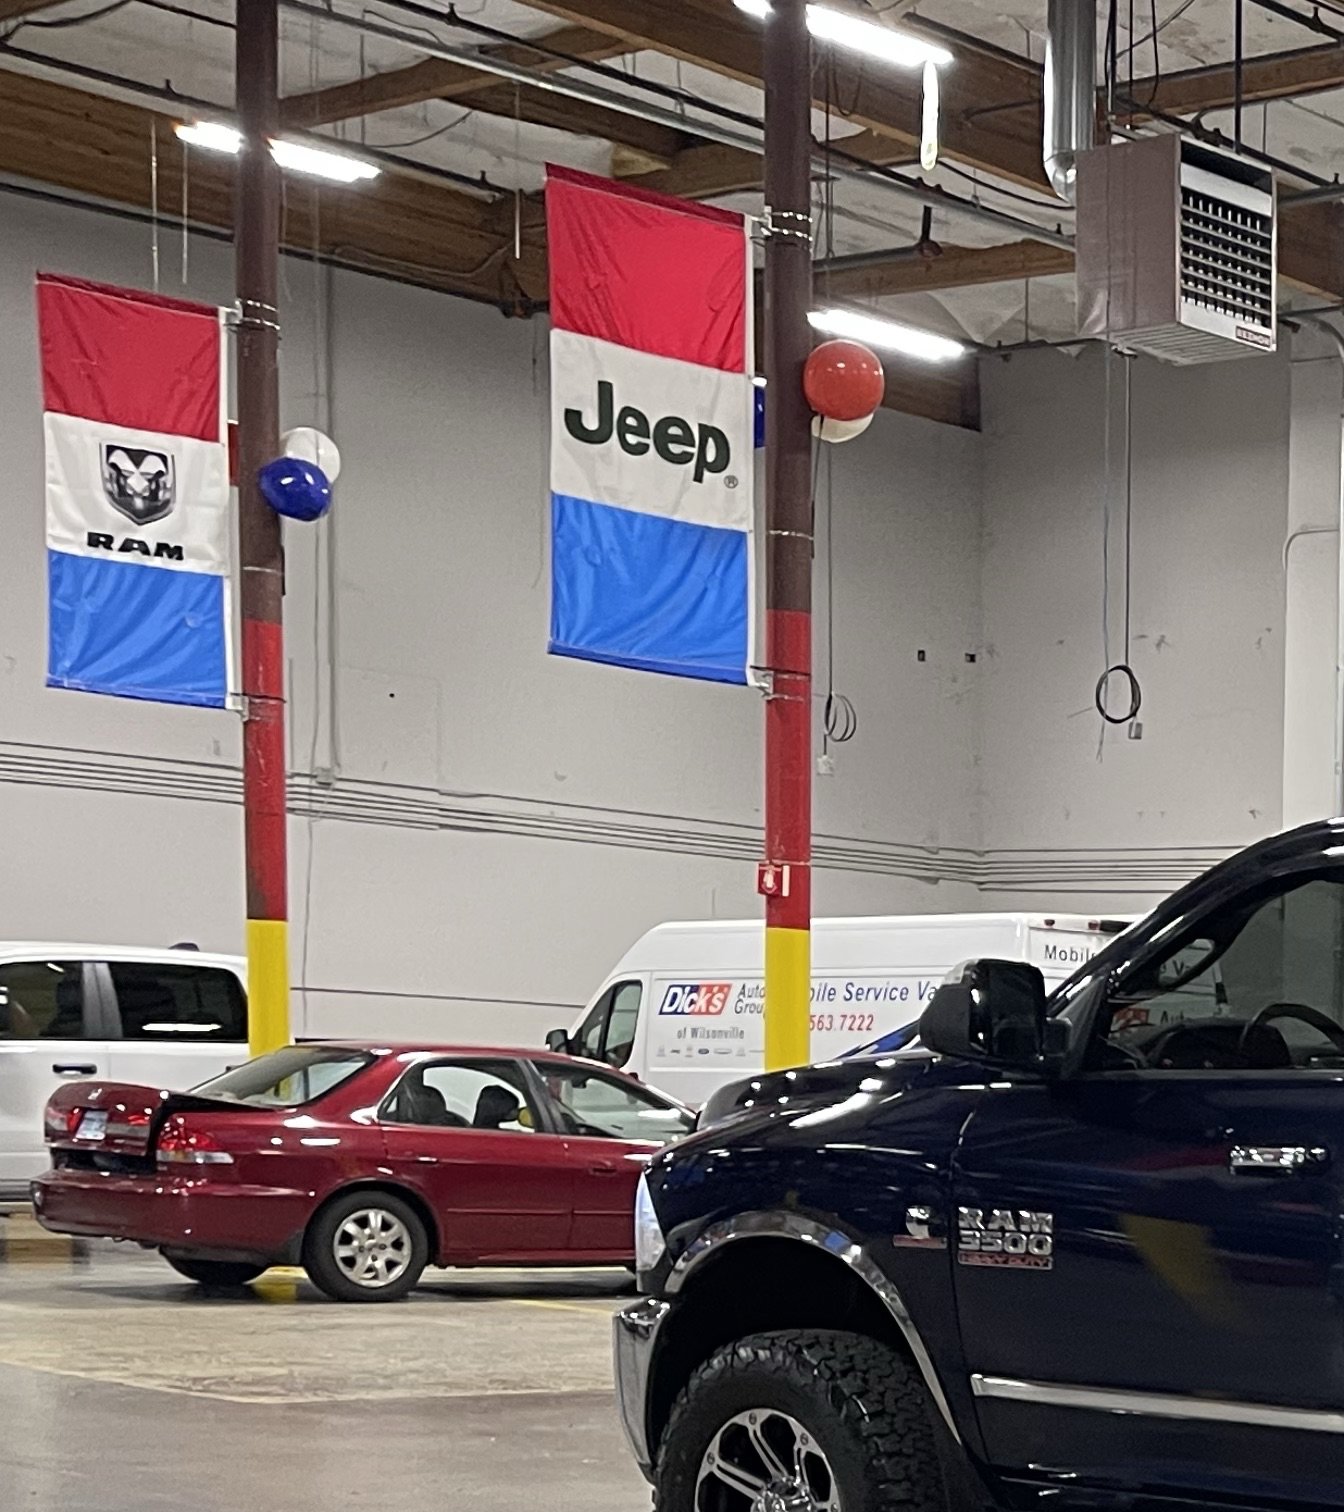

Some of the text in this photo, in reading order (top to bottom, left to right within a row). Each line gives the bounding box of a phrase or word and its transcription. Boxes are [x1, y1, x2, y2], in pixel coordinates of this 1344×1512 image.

[564, 380, 731, 484] Jeep
[87, 531, 184, 561] RAM
[843, 981, 909, 1001] Service
[917, 980, 938, 1001] Va
[734, 999, 767, 1019] Grou
[677, 1027, 745, 1040] of Wilsonville
[958, 1206, 1053, 1234] RAM
[958, 1229, 1053, 1256] 3500
